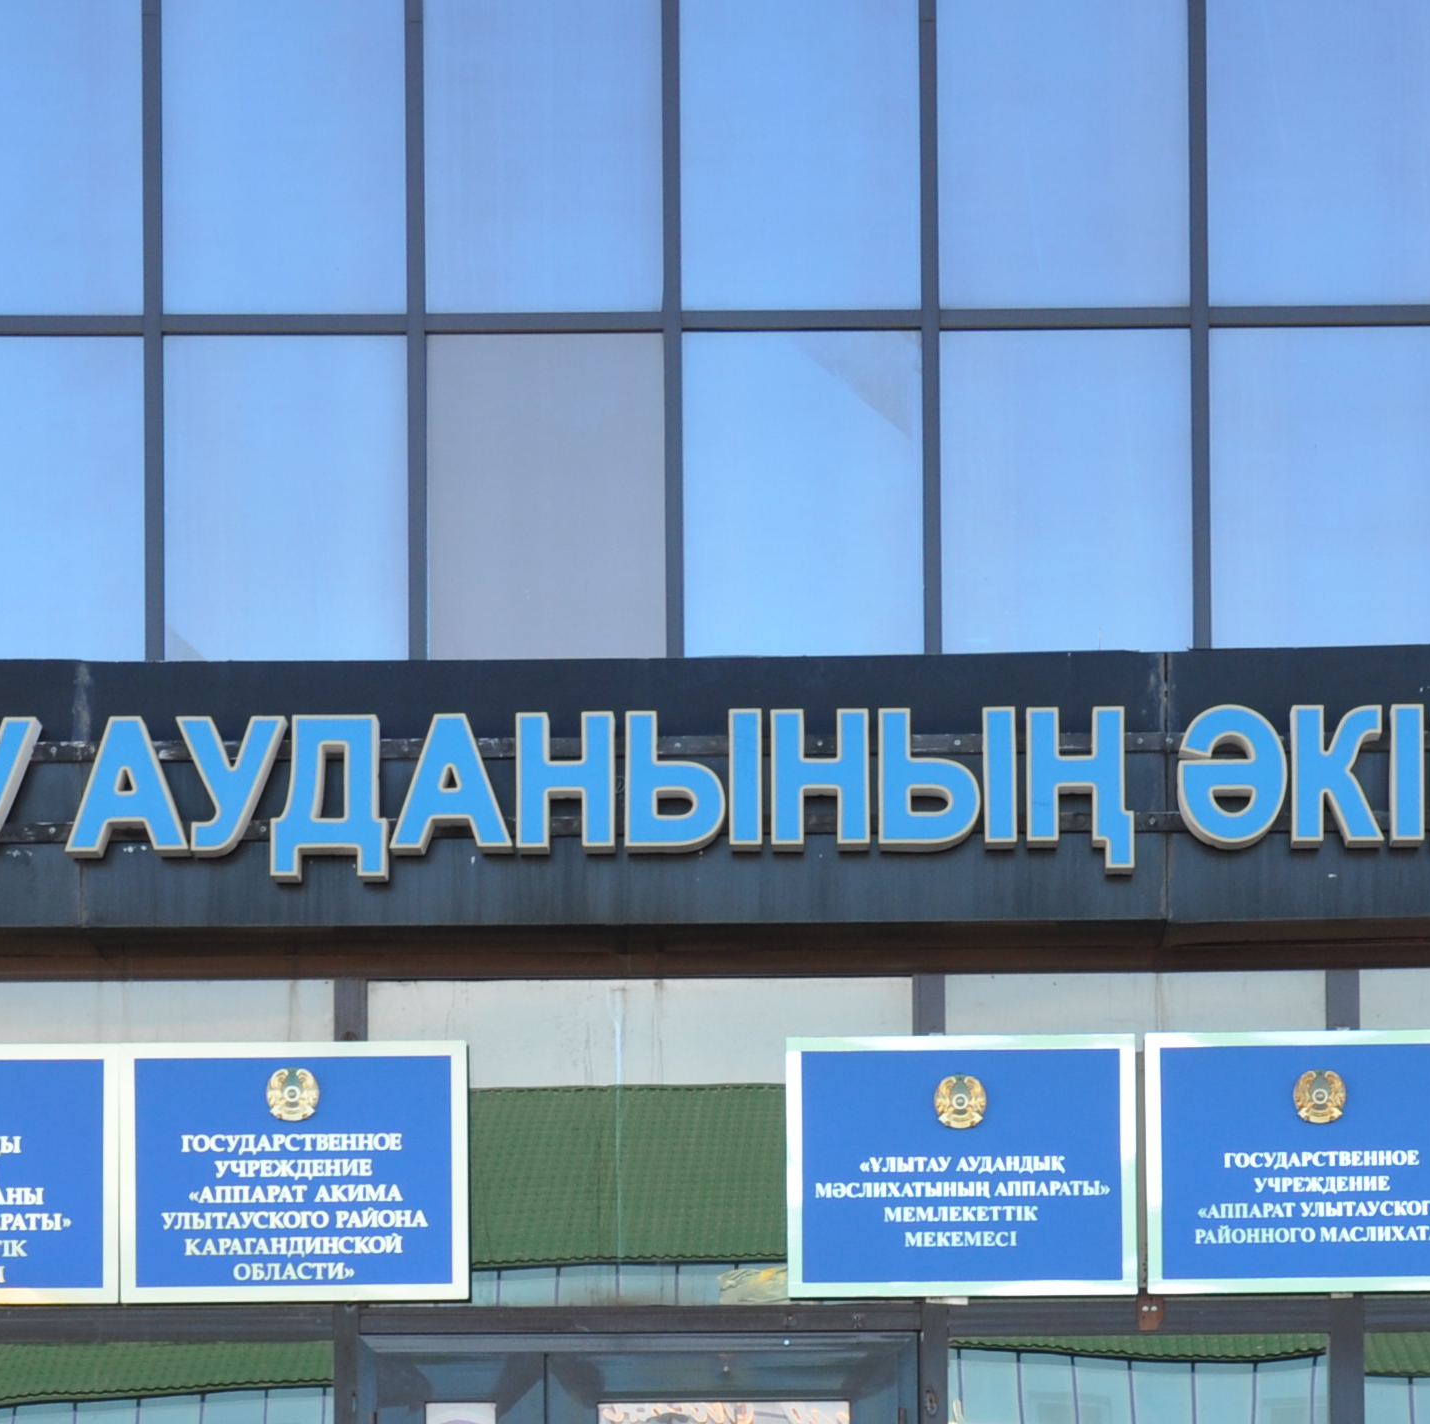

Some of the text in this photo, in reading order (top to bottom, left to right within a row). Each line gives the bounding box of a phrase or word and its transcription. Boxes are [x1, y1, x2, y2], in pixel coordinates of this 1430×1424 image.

[65, 705, 1135, 884] АУДАНЫНЫҢ
[180, 1132, 403, 1156] ГОСУДАРСТВЕННОЕ
[213, 1158, 373, 1181] УЧРЕЖДЕНИЕ
[955, 1155, 1067, 1175] АУДАНДЫҚ
[1223, 1149, 1421, 1171] ГОСУДАРСТВЕННОЕ
[187, 1184, 404, 1204] «АППАРАТ АКИМА
[814, 1180, 1112, 1199] МӘСЛИХАТЫНЫҢ АППАРАТЫ»
[1253, 1175, 1391, 1195] УЧРЕЖДЕНИЕ
[160, 1207, 429, 1231] УЛЫТАУСКОГО РАЙОНА
[883, 1205, 1039, 1223] МЕМЛЕКЕТТІК
[1197, 1201, 1296, 1219] «АППАРАТ
[904, 1230, 1018, 1248] МЕКЕМЕСІ
[1194, 1225, 1316, 1245] РАЙОННОГО
[184, 1232, 404, 1259] КАРАГАНДИНСКОЙ
[232, 1261, 356, 1281] ОБЛАСТИ»
